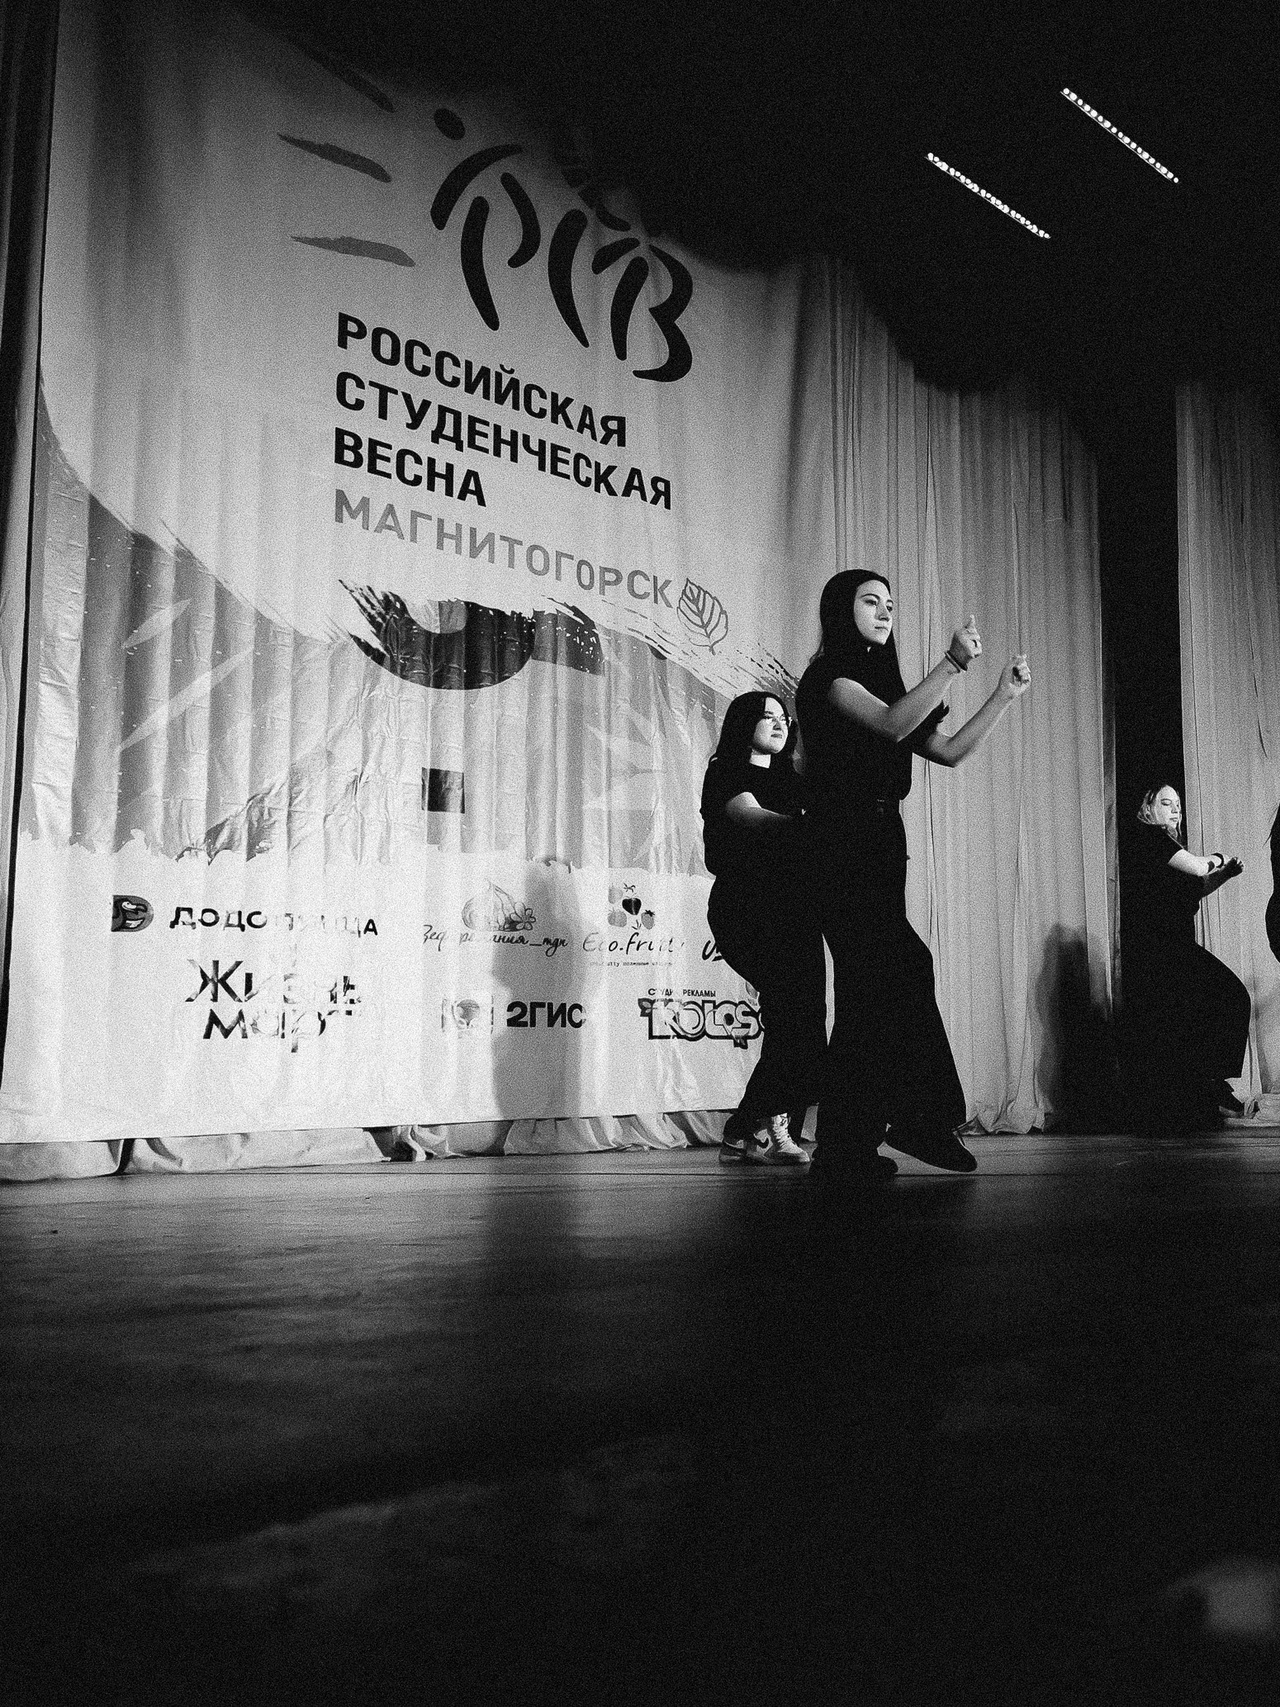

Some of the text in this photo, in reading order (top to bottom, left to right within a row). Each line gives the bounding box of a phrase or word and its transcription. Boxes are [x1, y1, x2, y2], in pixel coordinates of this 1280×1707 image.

[335, 370, 672, 510] СТУДЕНЧЕСКАЯ
[337, 311, 627, 448] РОССИЙСКАЯ
[334, 426, 487, 507] ВЕСНА
[334, 488, 674, 609] МАГНИТОГОРСК
[506, 1000, 587, 1029] 2ГИС
